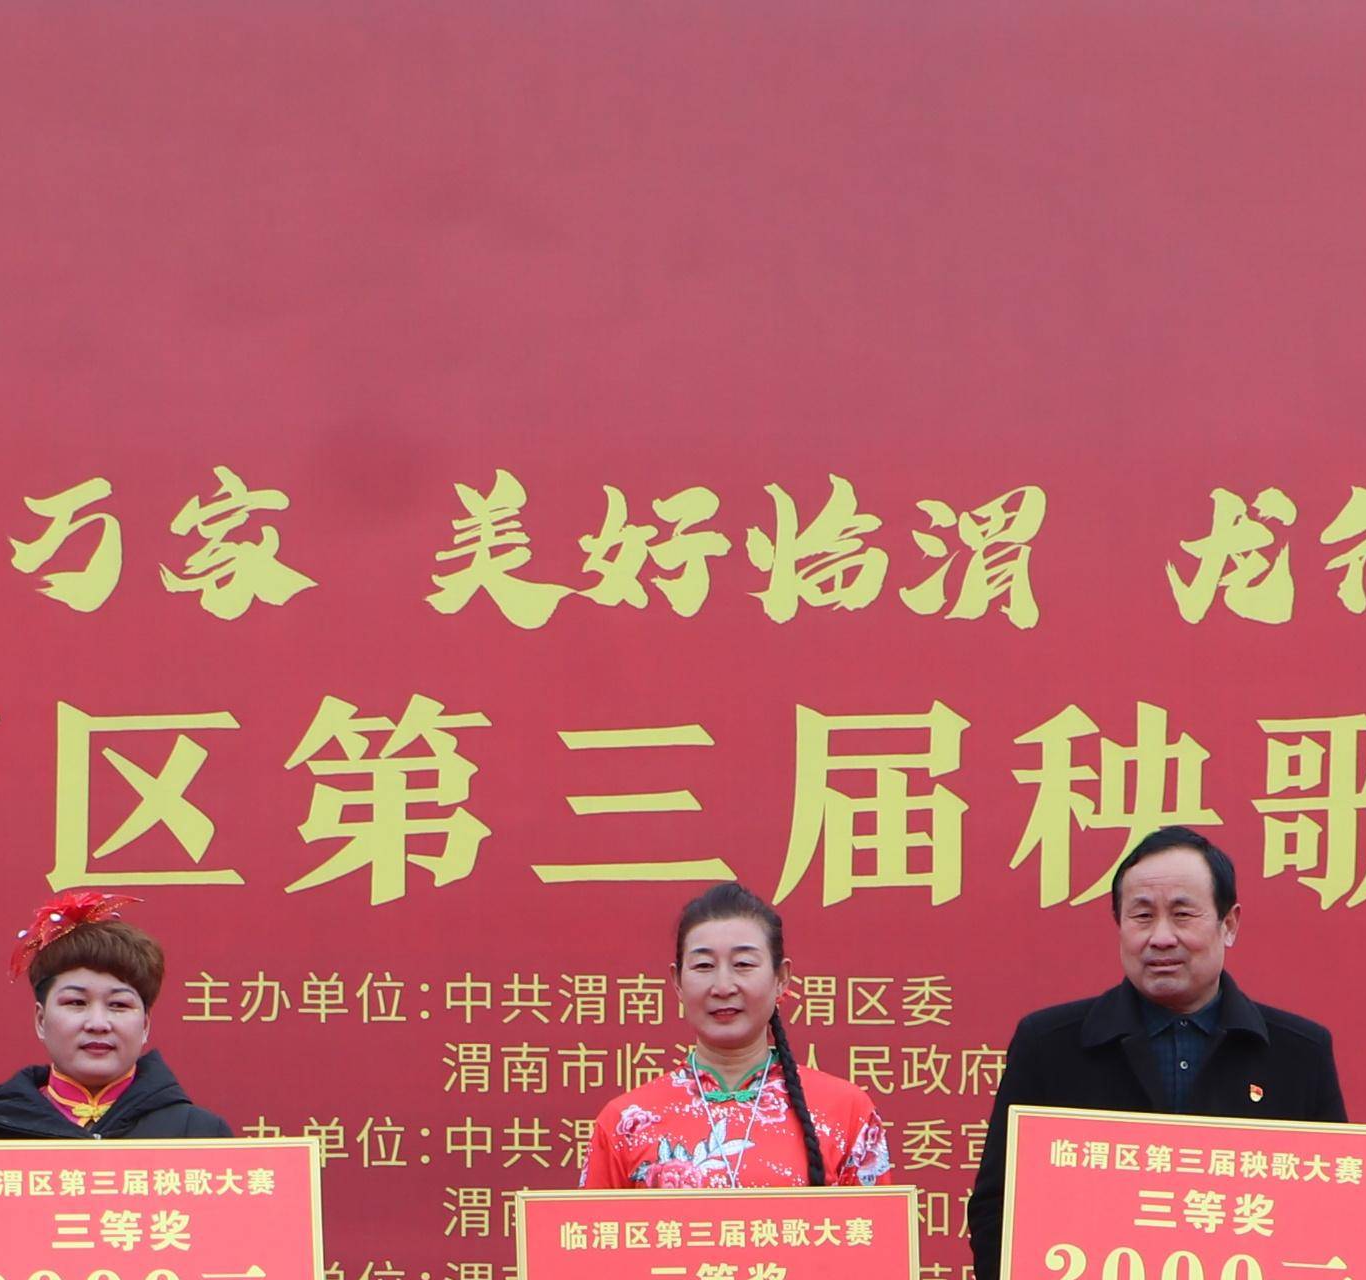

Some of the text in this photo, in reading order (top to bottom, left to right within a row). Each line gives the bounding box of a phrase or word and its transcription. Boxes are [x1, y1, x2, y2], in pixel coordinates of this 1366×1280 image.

[425, 468, 1048, 630] 美好临渭
[182, 970, 954, 1027] 主办单位：中共渭南渭区委
[442, 1041, 1008, 1097] 渭南市临人民政府
[1049, 1138, 1365, 1186] 临渭区第三届秧歌大赛
[50, 1208, 193, 1252] 三等奖
[559, 1216, 875, 1251] 临渭区第三届秧歌大赛
[1133, 1188, 1277, 1237] 三等奖
